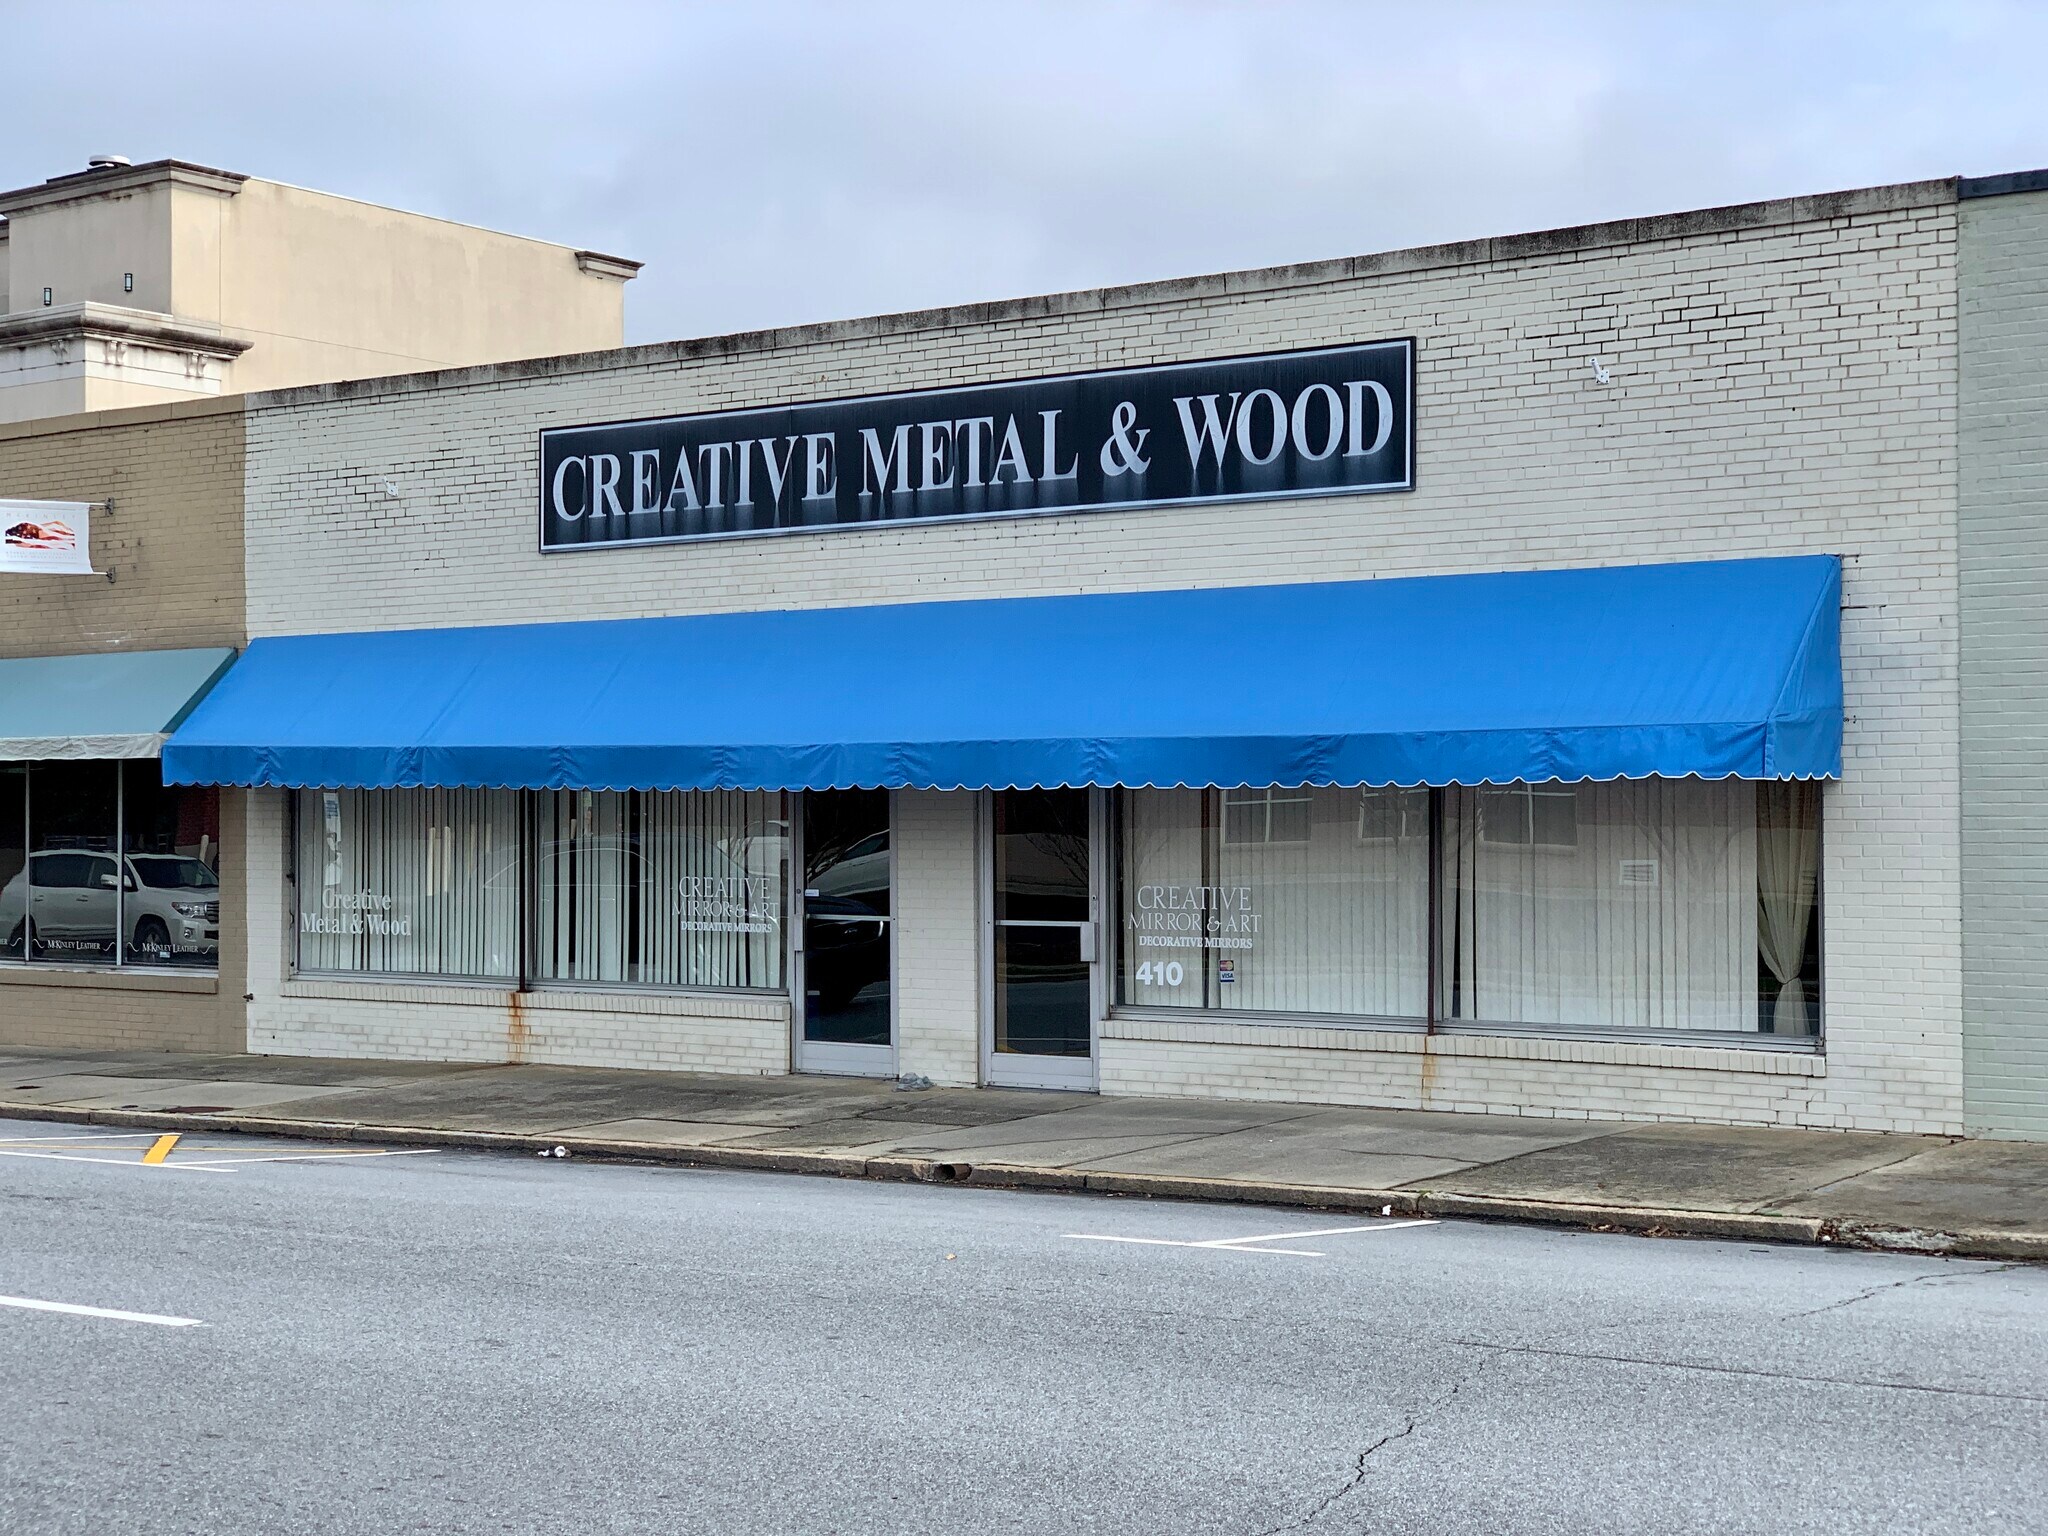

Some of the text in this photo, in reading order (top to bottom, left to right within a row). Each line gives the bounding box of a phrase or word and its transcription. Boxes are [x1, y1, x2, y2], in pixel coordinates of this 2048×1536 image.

[552, 379, 1394, 522] CREATIVE METAL & WOOD
[679, 877, 770, 898] CREATIVE
[322, 888, 392, 911] Creative
[672, 900, 778, 918] MIRROR & ART
[1137, 886, 1252, 911] CREATIVE
[301, 912, 411, 936] Metal & Wood
[681, 921, 772, 933] DECORATIVE MIRRORS
[1128, 912, 1262, 933] MIRROR & ART
[76, 940, 101, 950] LEATHER
[172, 943, 199, 953] LEATHER
[1139, 935, 1253, 949] DECORATIVE MIRRORS
[1135, 961, 1184, 986] 410
